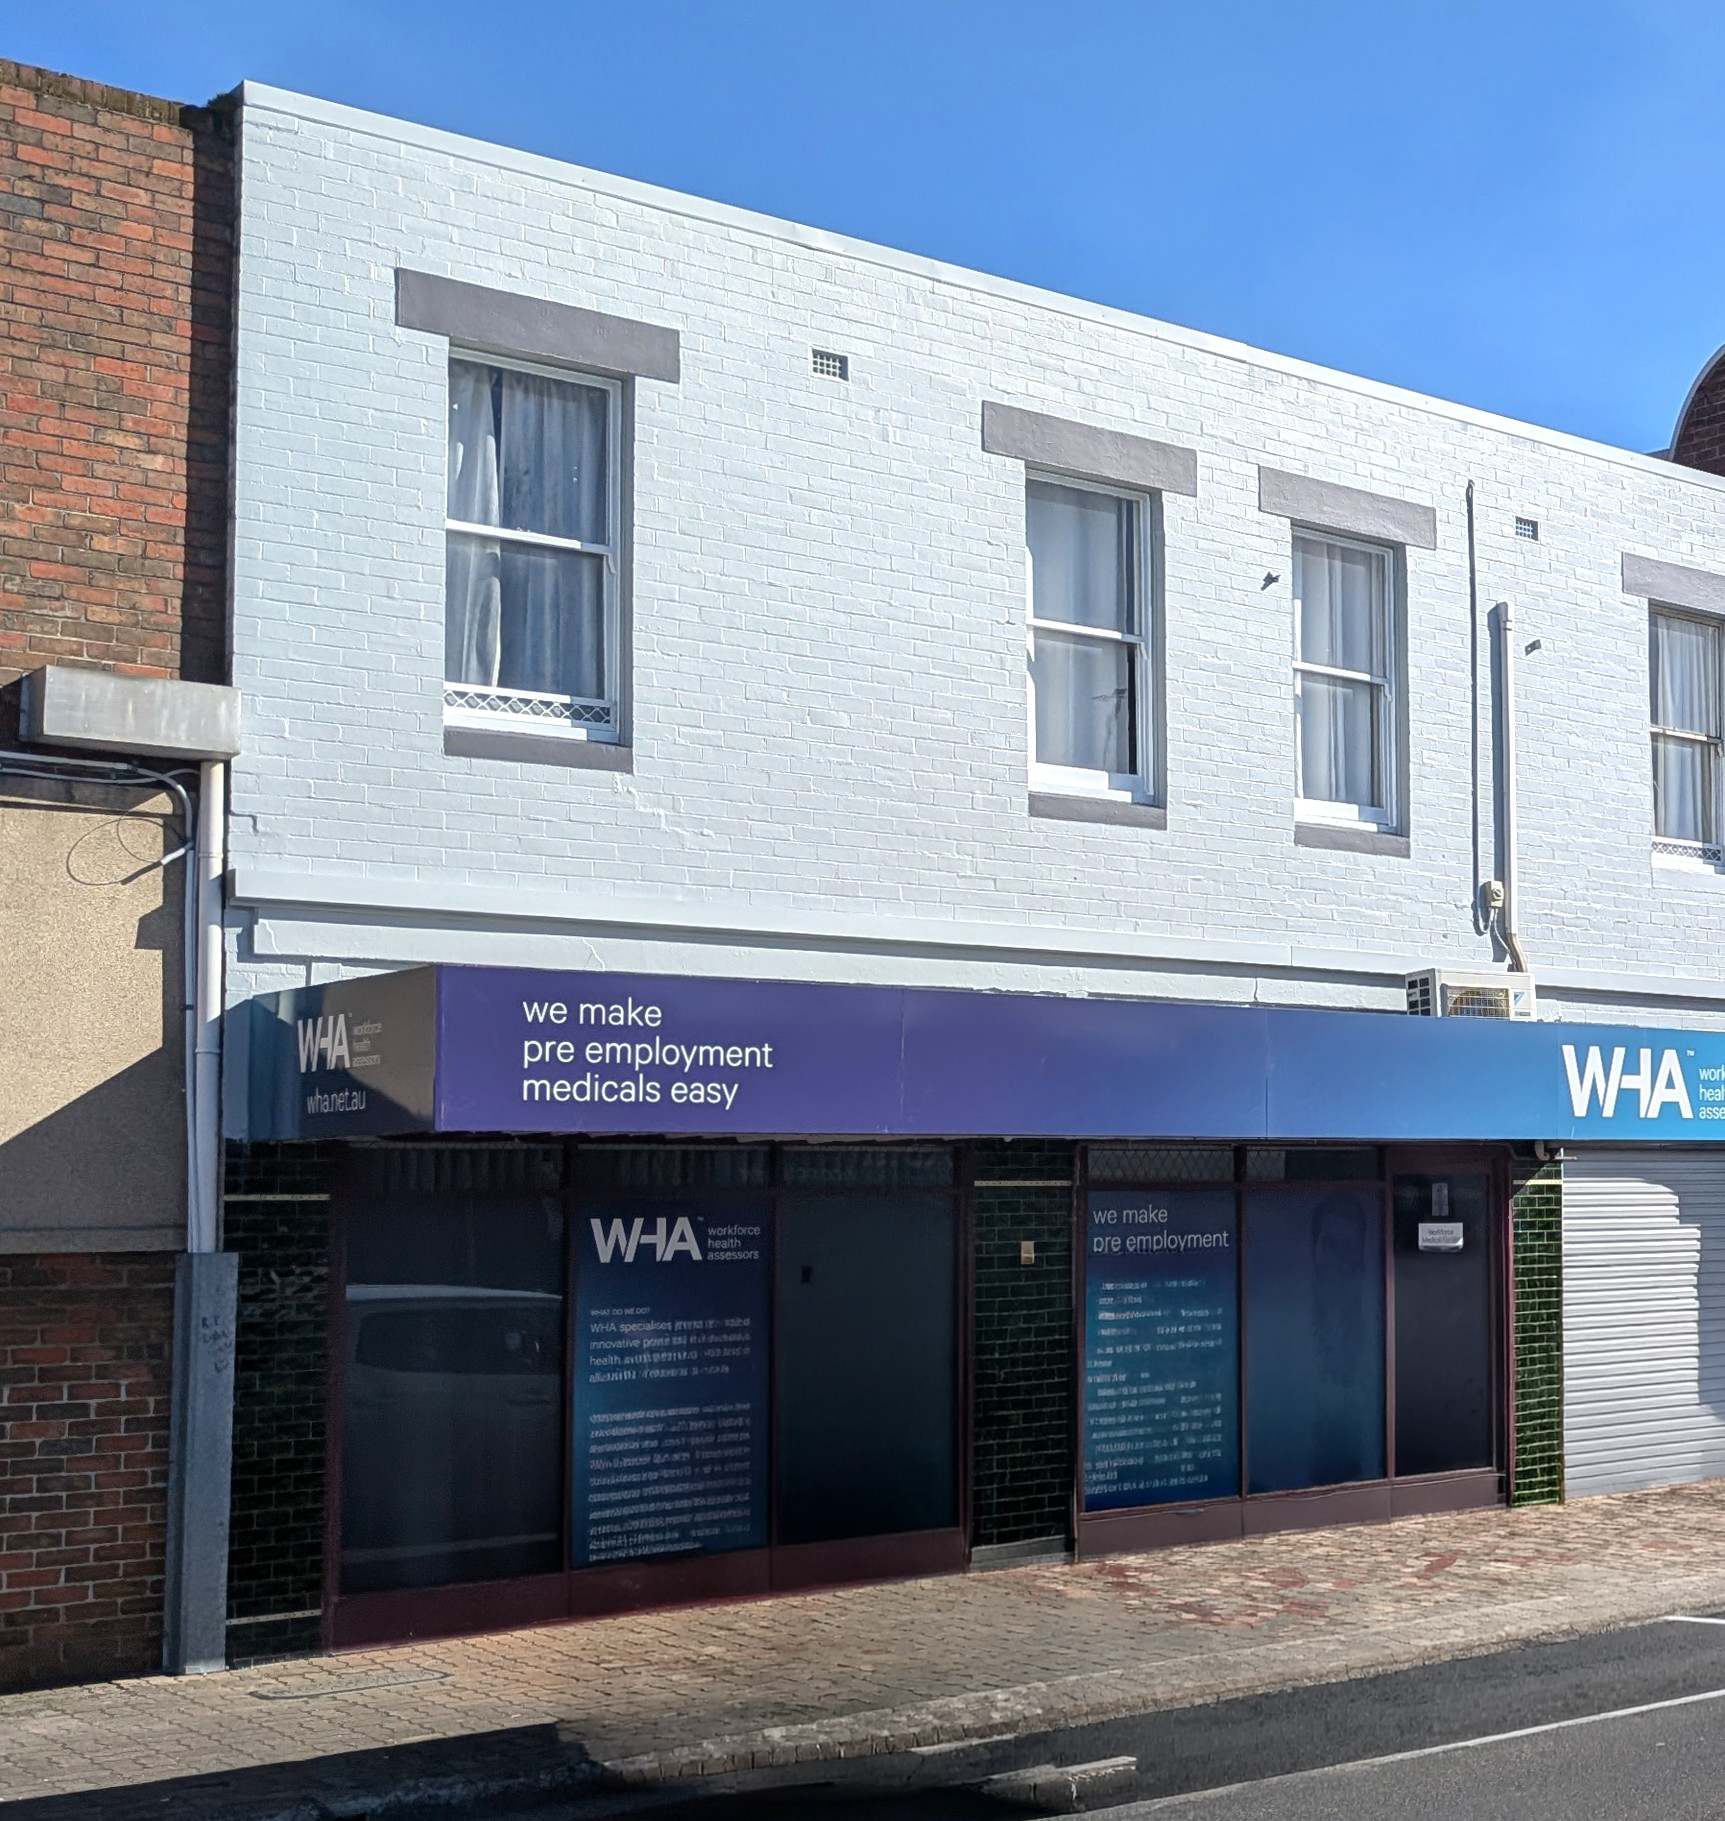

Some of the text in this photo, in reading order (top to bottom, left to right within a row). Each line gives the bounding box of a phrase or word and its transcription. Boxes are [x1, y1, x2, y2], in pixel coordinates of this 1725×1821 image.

[523, 996, 662, 1027] we make
[297, 1013, 351, 1073] WHA
[523, 1035, 773, 1072] pre employment
[523, 1072, 738, 1110] medicals easy
[1562, 1044, 1694, 1119] WHA
[307, 1087, 366, 1114] wha.net.au
[1093, 1204, 1168, 1224] we make
[590, 1216, 703, 1264] WHA
[708, 1224, 761, 1236] workforce
[1093, 1230, 1229, 1252] pre employment
[707, 1249, 759, 1260] assessors
[708, 1238, 741, 1249] health
[590, 1323, 617, 1333] WHA
[620, 1319, 672, 1334] specialises
[590, 1354, 621, 1366] health
